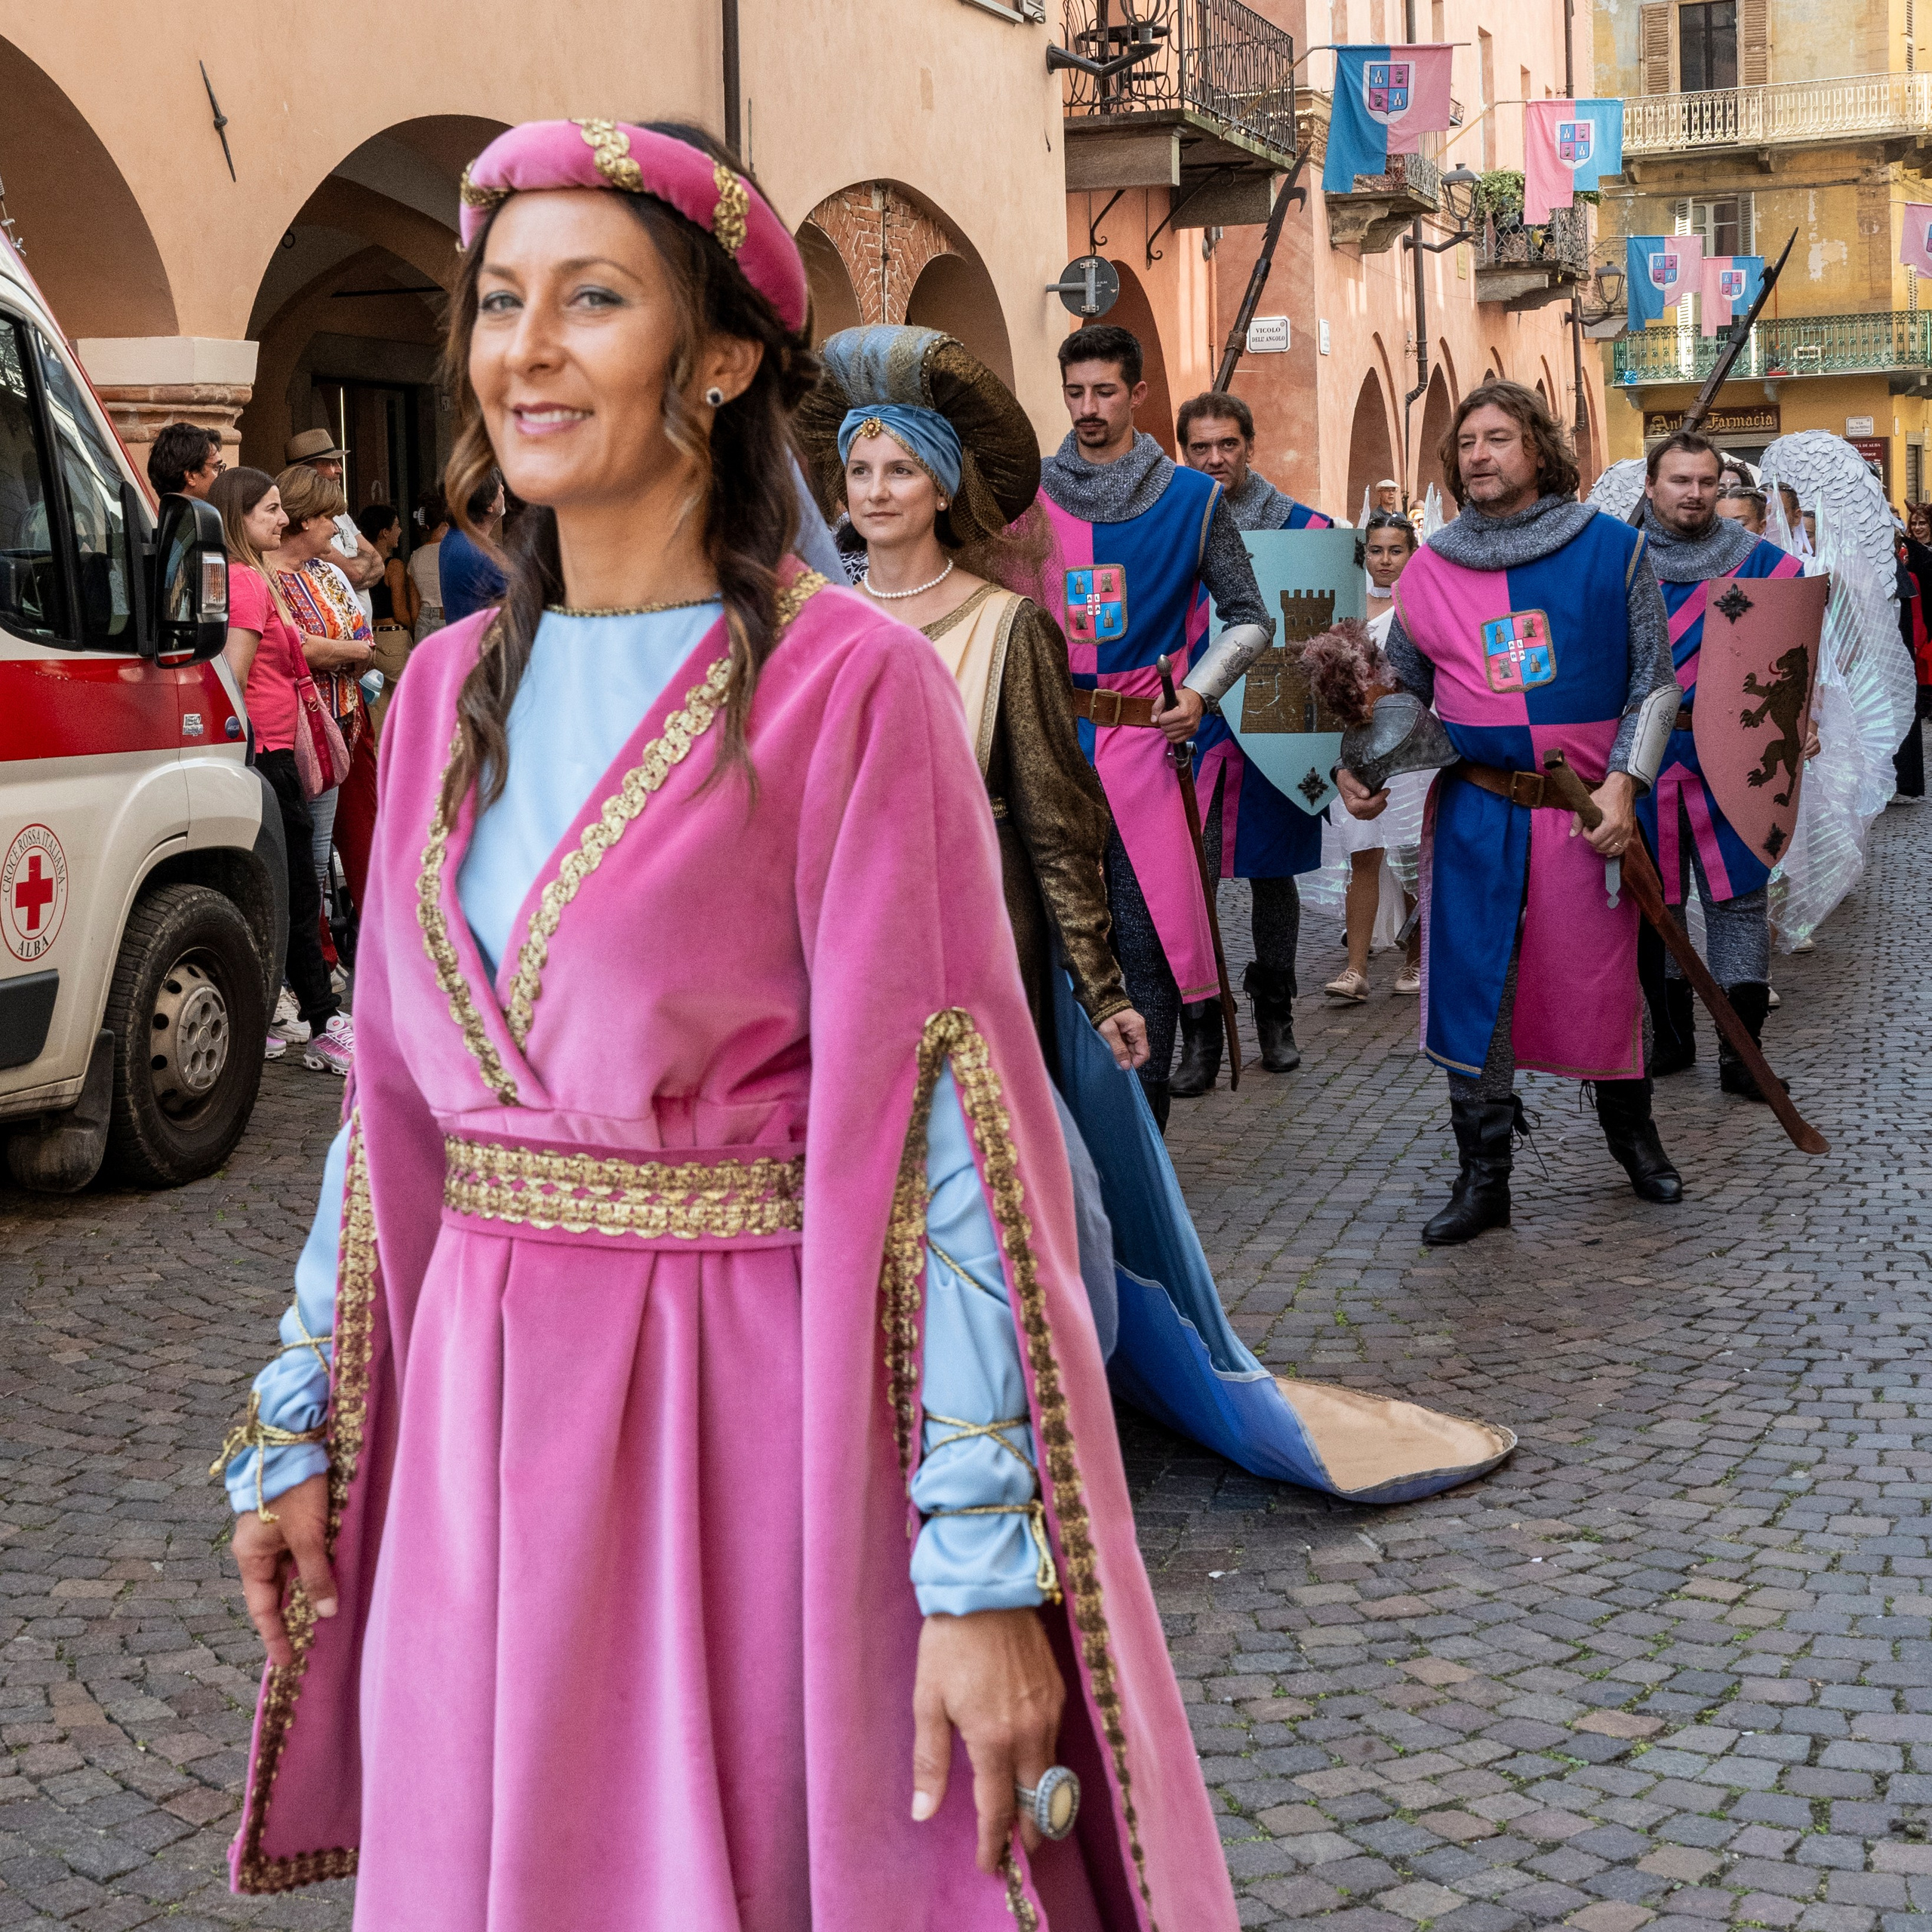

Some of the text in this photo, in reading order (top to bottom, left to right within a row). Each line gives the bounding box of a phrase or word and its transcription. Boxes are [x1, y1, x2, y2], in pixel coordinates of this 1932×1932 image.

[1705, 412, 1774, 432] Farmacia
[2, 829, 66, 893] CROCE ROSSA ITALIANA
[17, 935, 49, 958] ALBA
